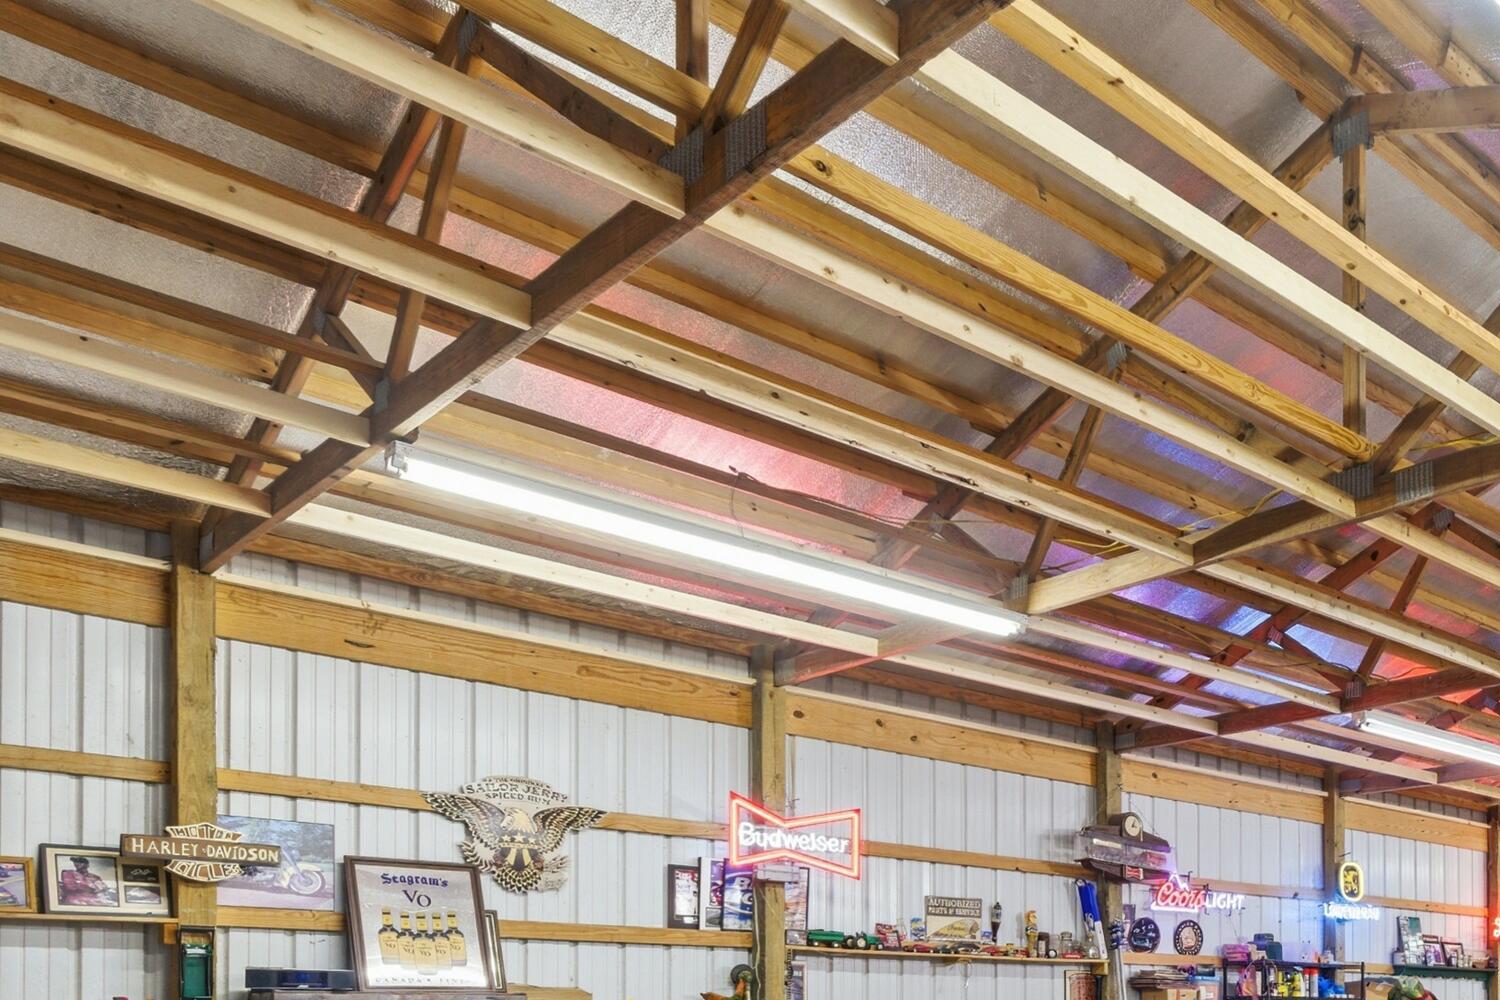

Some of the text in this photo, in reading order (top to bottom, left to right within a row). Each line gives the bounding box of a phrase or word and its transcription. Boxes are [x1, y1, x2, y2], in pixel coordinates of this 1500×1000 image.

[466, 782, 568, 803] SAILOR JERRY
[485, 792, 524, 801] SPICED
[737, 821, 850, 854] Budweiser
[380, 873, 449, 888] Seagram's
[402, 889, 432, 908] VO
[928, 899, 981, 909] AUTHORIZED
[1157, 881, 1246, 910] Coors LIGHT
